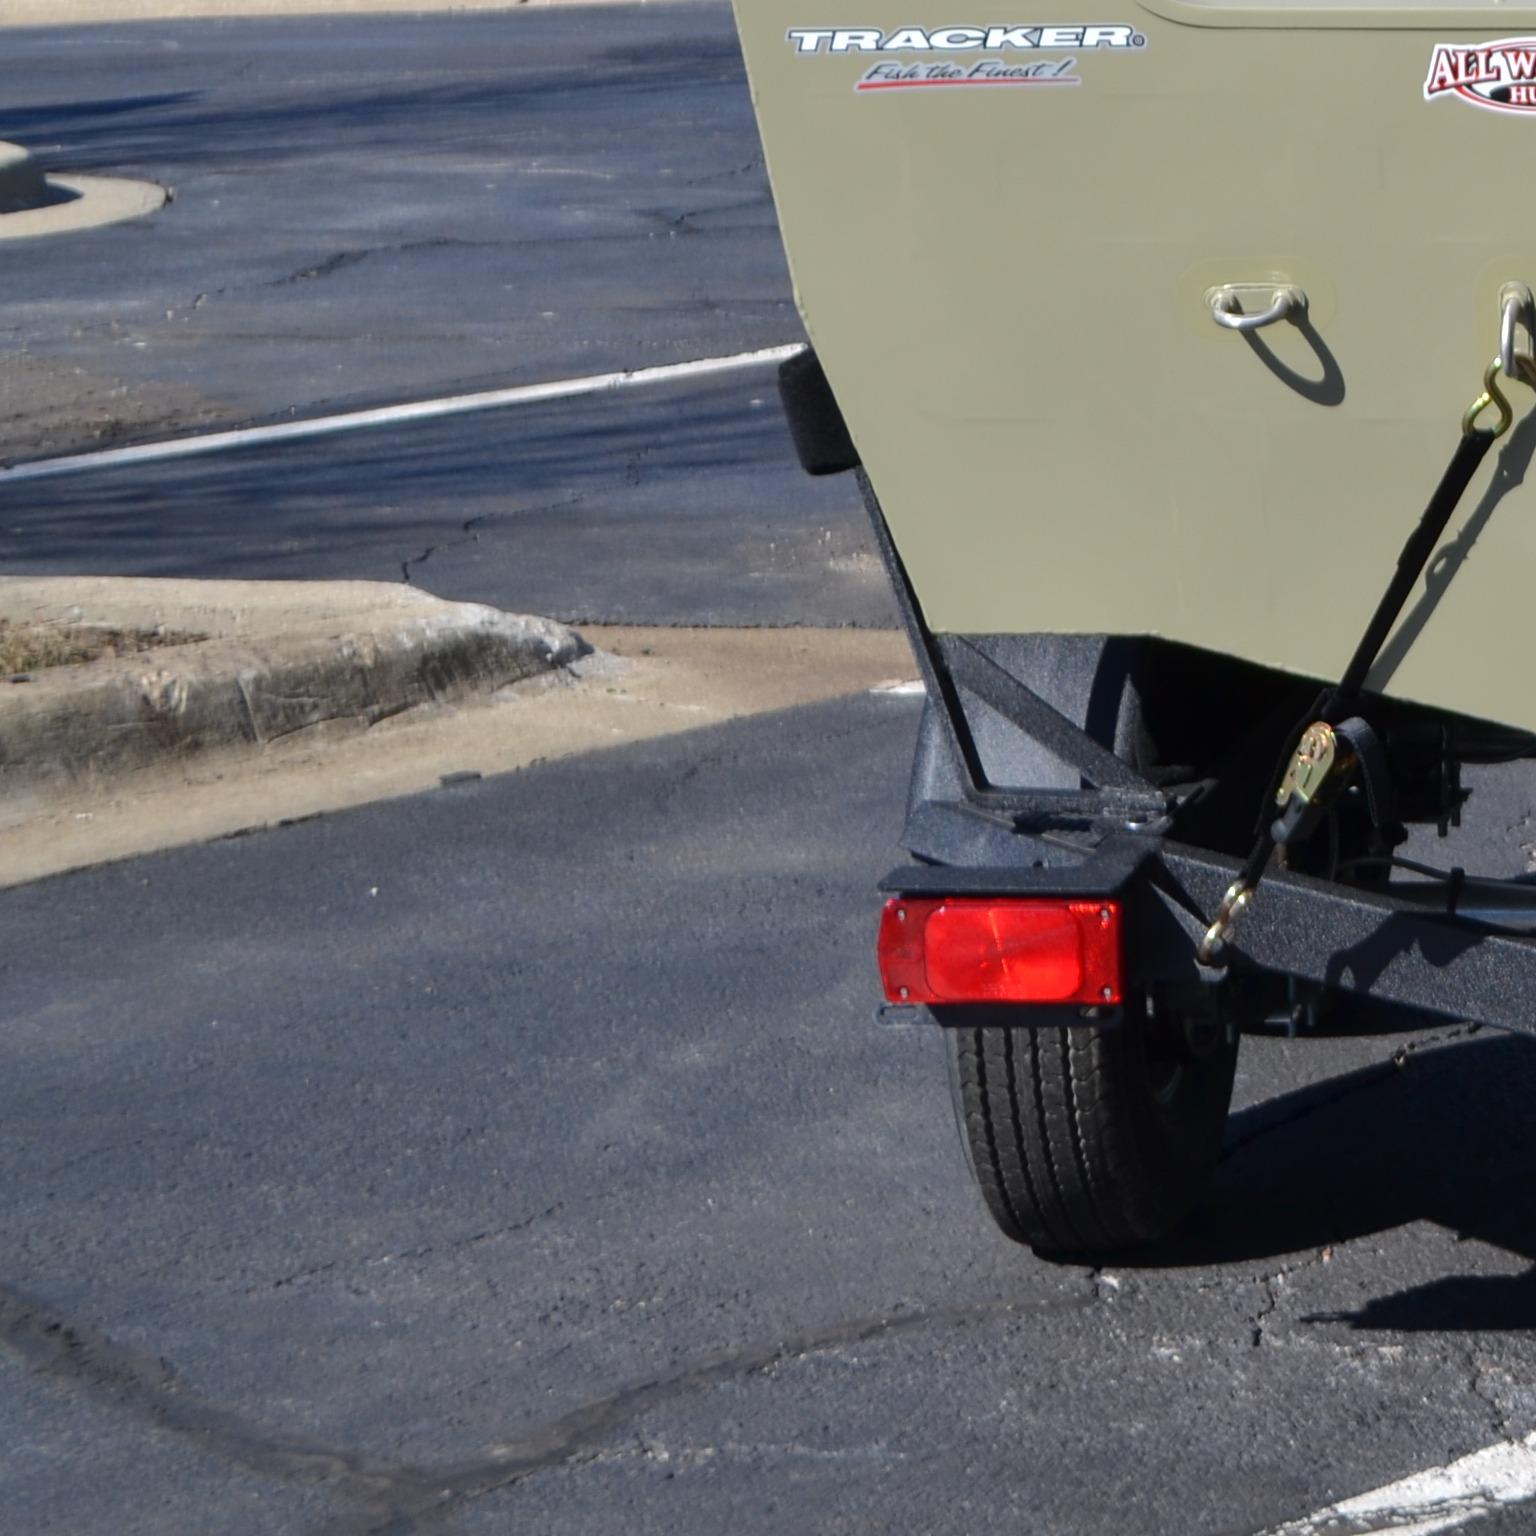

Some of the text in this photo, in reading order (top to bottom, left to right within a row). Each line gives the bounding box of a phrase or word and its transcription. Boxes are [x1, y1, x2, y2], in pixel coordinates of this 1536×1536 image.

[788, 25, 1134, 53] TRACKER
[865, 63, 920, 80] Fish
[925, 64, 963, 79] the
[1427, 48, 1500, 94] ALL
